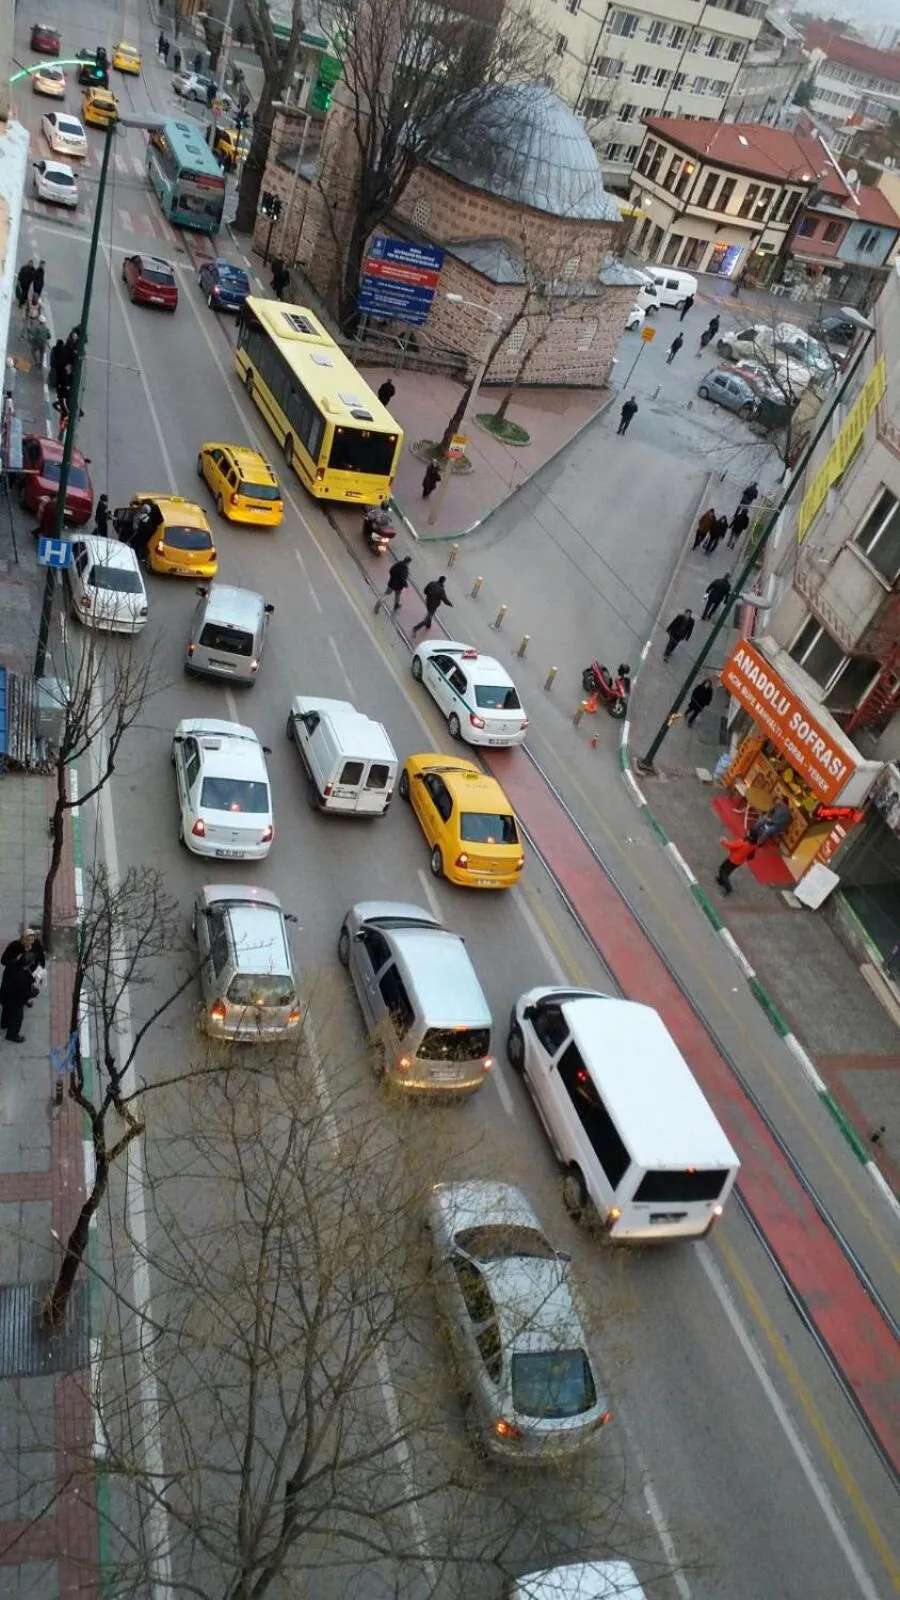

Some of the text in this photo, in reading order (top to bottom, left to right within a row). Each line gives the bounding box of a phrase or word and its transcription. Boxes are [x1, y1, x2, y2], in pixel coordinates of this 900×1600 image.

[44, 540, 67, 563] H
[733, 648, 791, 717] ANADOLU
[789, 712, 847, 782] SOFRASI
